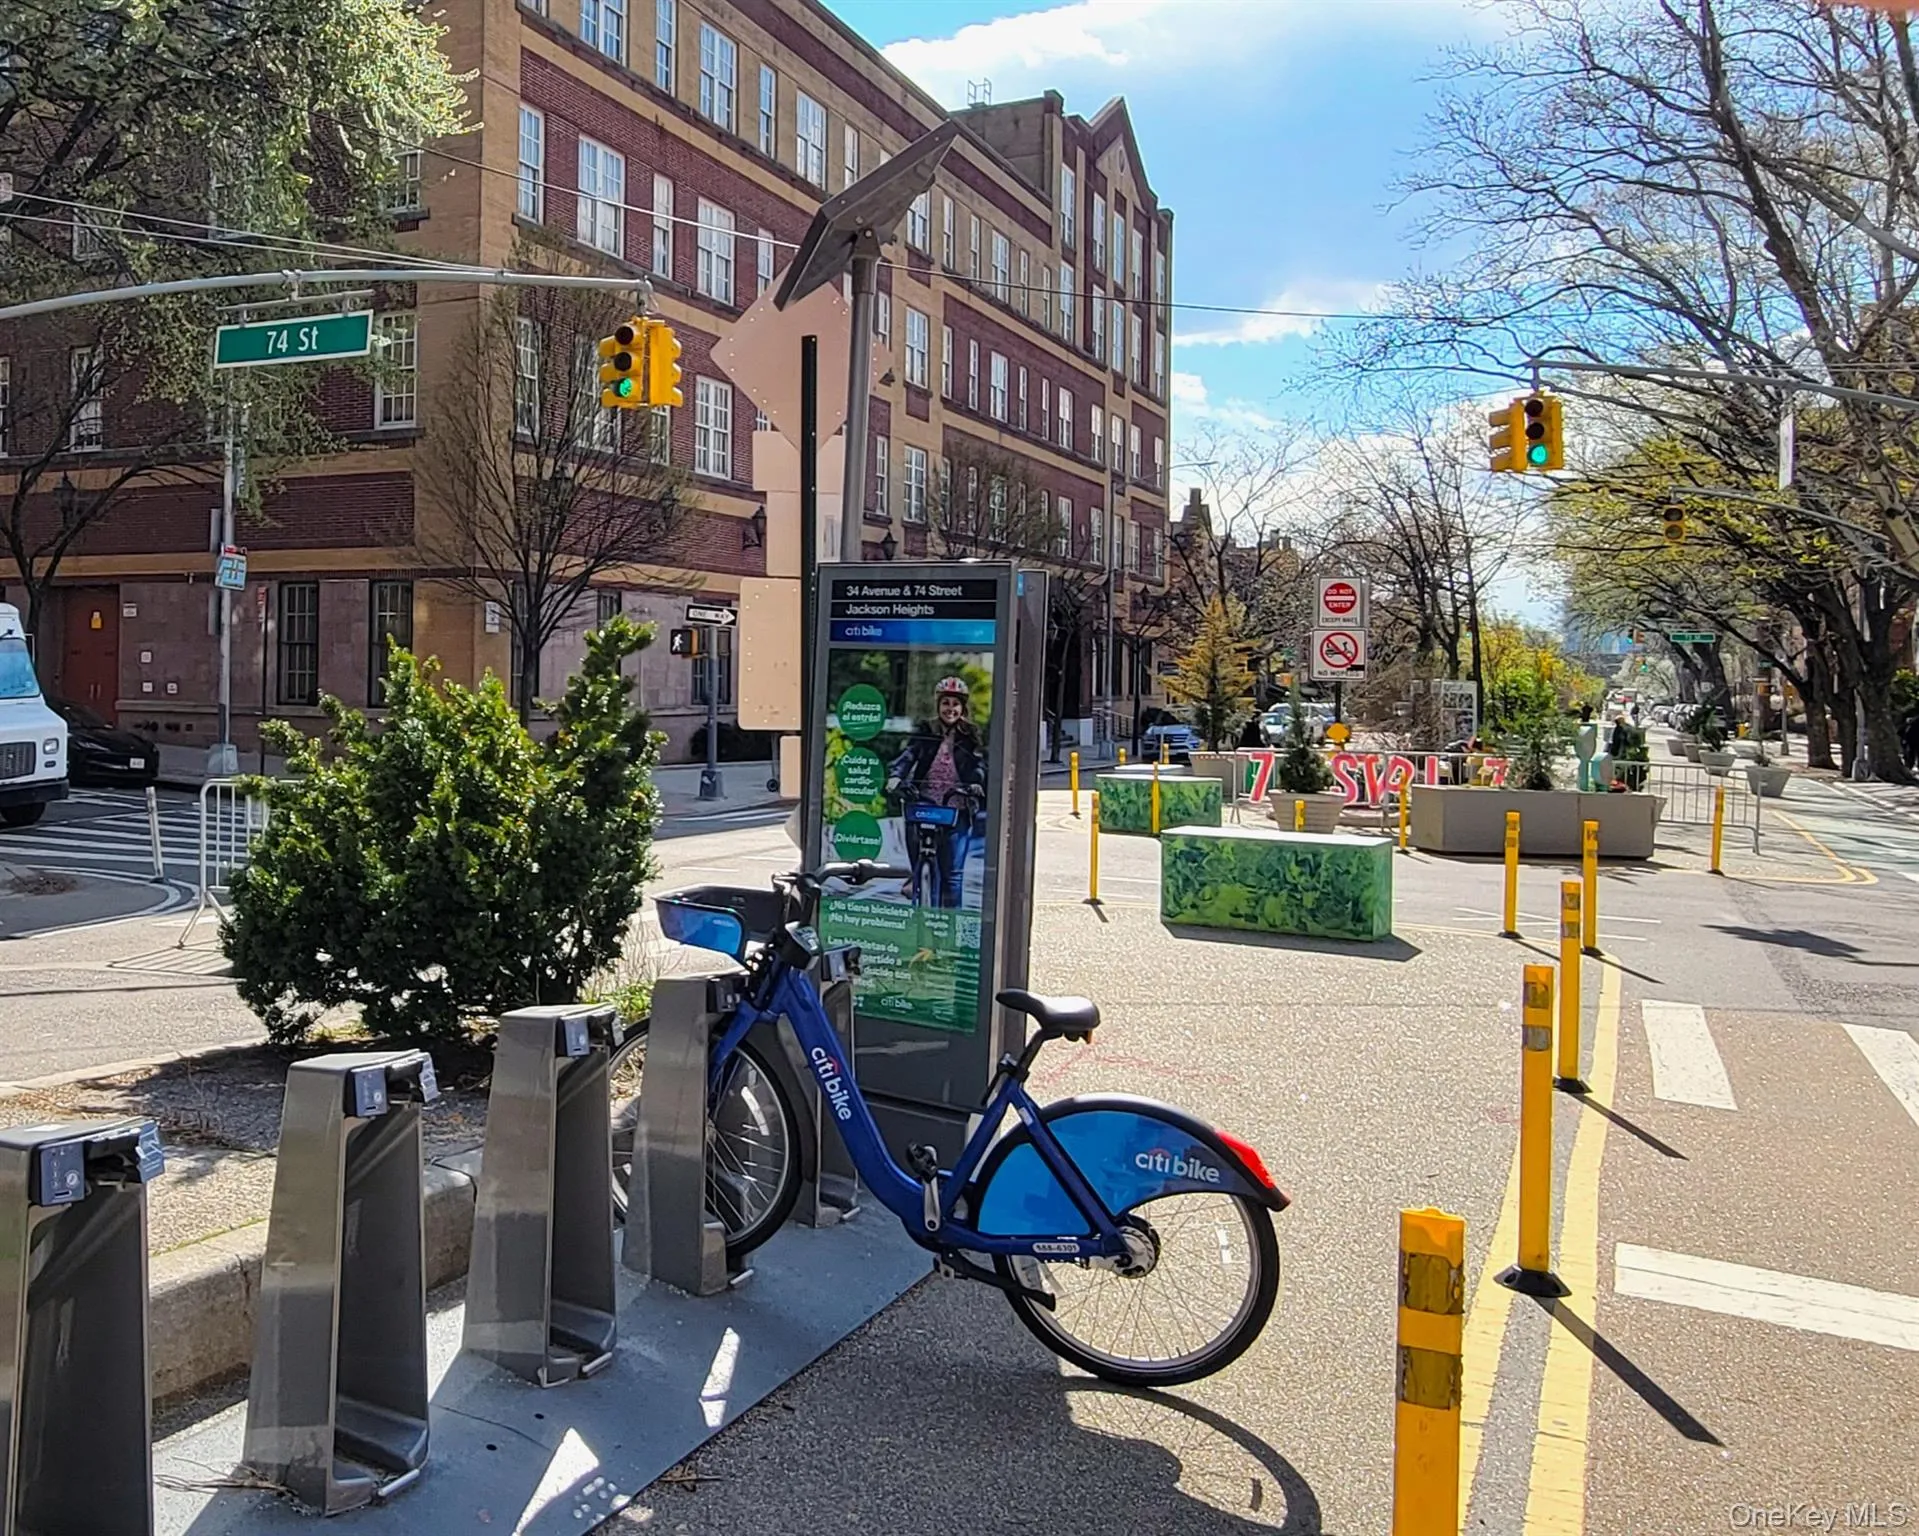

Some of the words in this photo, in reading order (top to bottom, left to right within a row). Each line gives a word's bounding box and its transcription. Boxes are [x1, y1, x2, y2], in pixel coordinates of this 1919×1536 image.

[267, 330, 288, 354] 74
[298, 326, 319, 351] St
[846, 585, 859, 596] 34
[861, 585, 900, 596] Avenue
[902, 585, 911, 596] &
[914, 585, 926, 596] 74
[928, 584, 963, 596] Street
[845, 604, 890, 615] Jackson
[892, 604, 935, 617] Heights
[847, 902, 869, 913] tiene
[844, 914, 860, 926] hay
[811, 1046, 835, 1079] citi
[825, 1077, 852, 1121] bike
[1135, 1151, 1170, 1173] citi
[1172, 1155, 1220, 1183] bike
